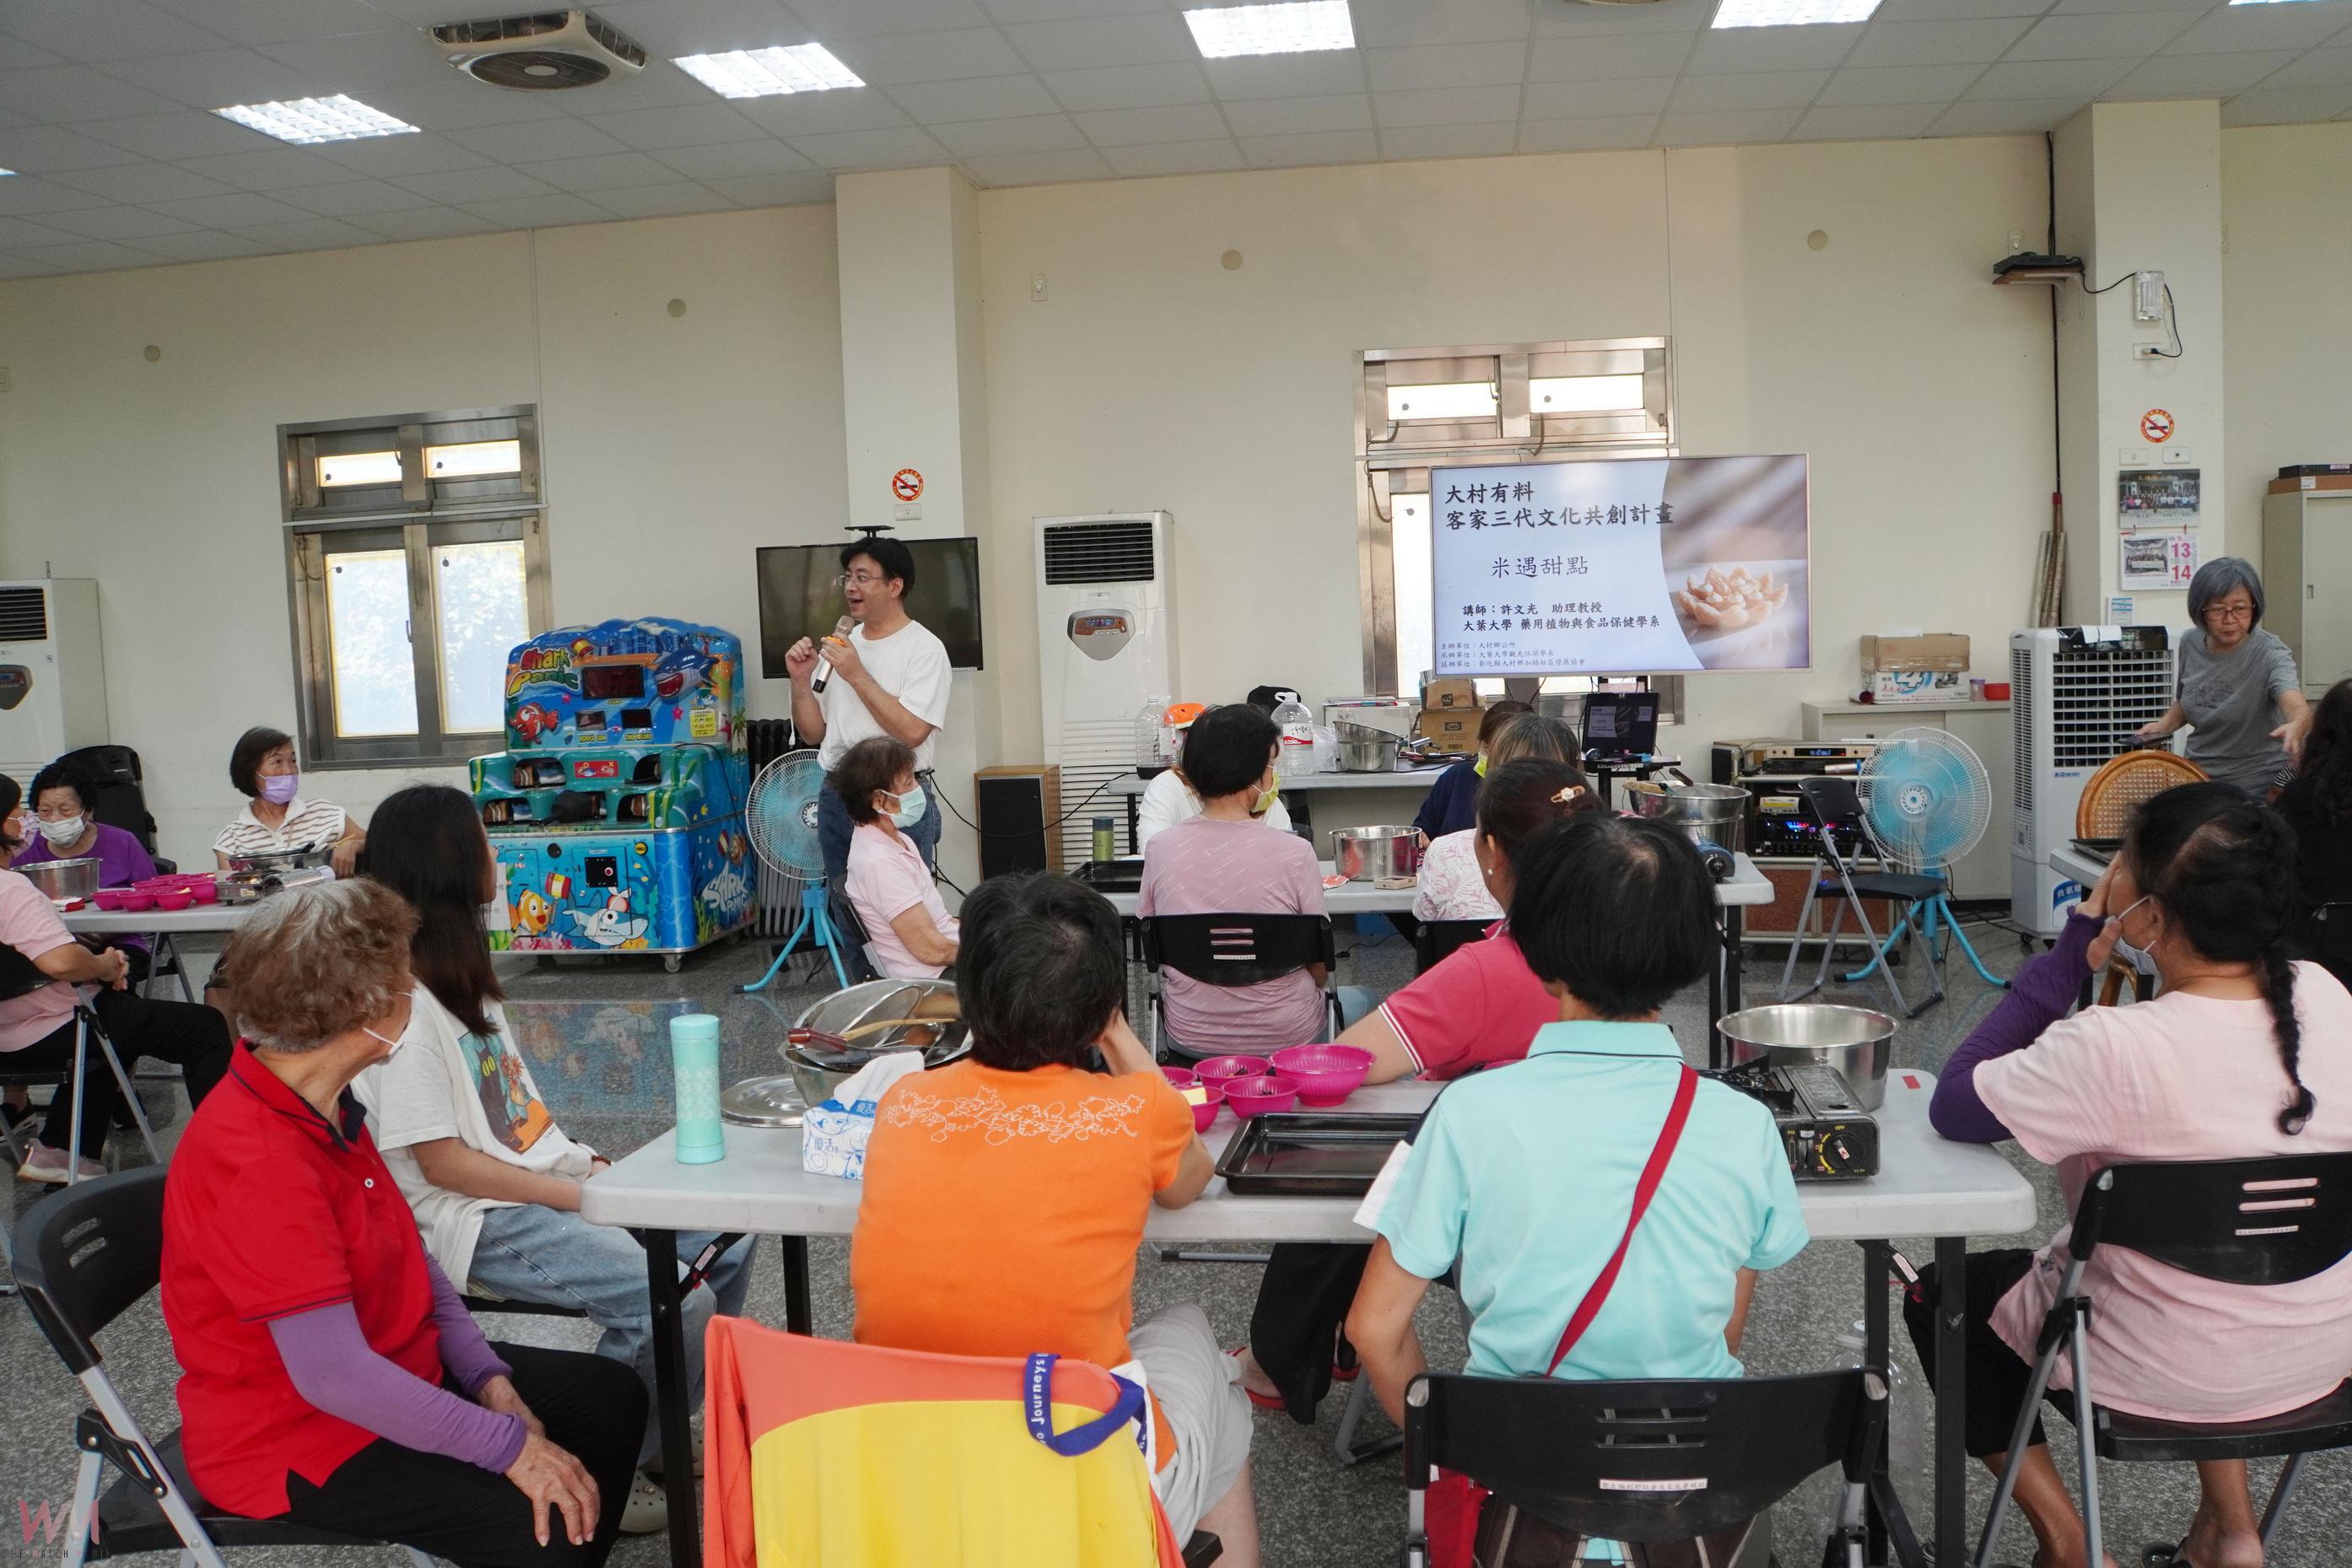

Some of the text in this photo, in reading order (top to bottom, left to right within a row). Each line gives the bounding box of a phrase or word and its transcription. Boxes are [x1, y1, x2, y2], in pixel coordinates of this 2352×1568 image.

[1444, 481, 1535, 504] 大村有料
[1445, 504, 1675, 531] 客家三代文化共創計畫
[2171, 542, 2192, 558] 13
[1491, 554, 1589, 579] 米遇甜點
[2171, 565, 2192, 580] 14
[1551, 601, 1603, 614] 助理教授
[1463, 615, 1660, 632] 大葉大學 藥用植物與食品保健學系
[521, 648, 570, 670] Shark
[508, 667, 579, 696] Panic
[1031, 1359, 1047, 1425] Journeys
